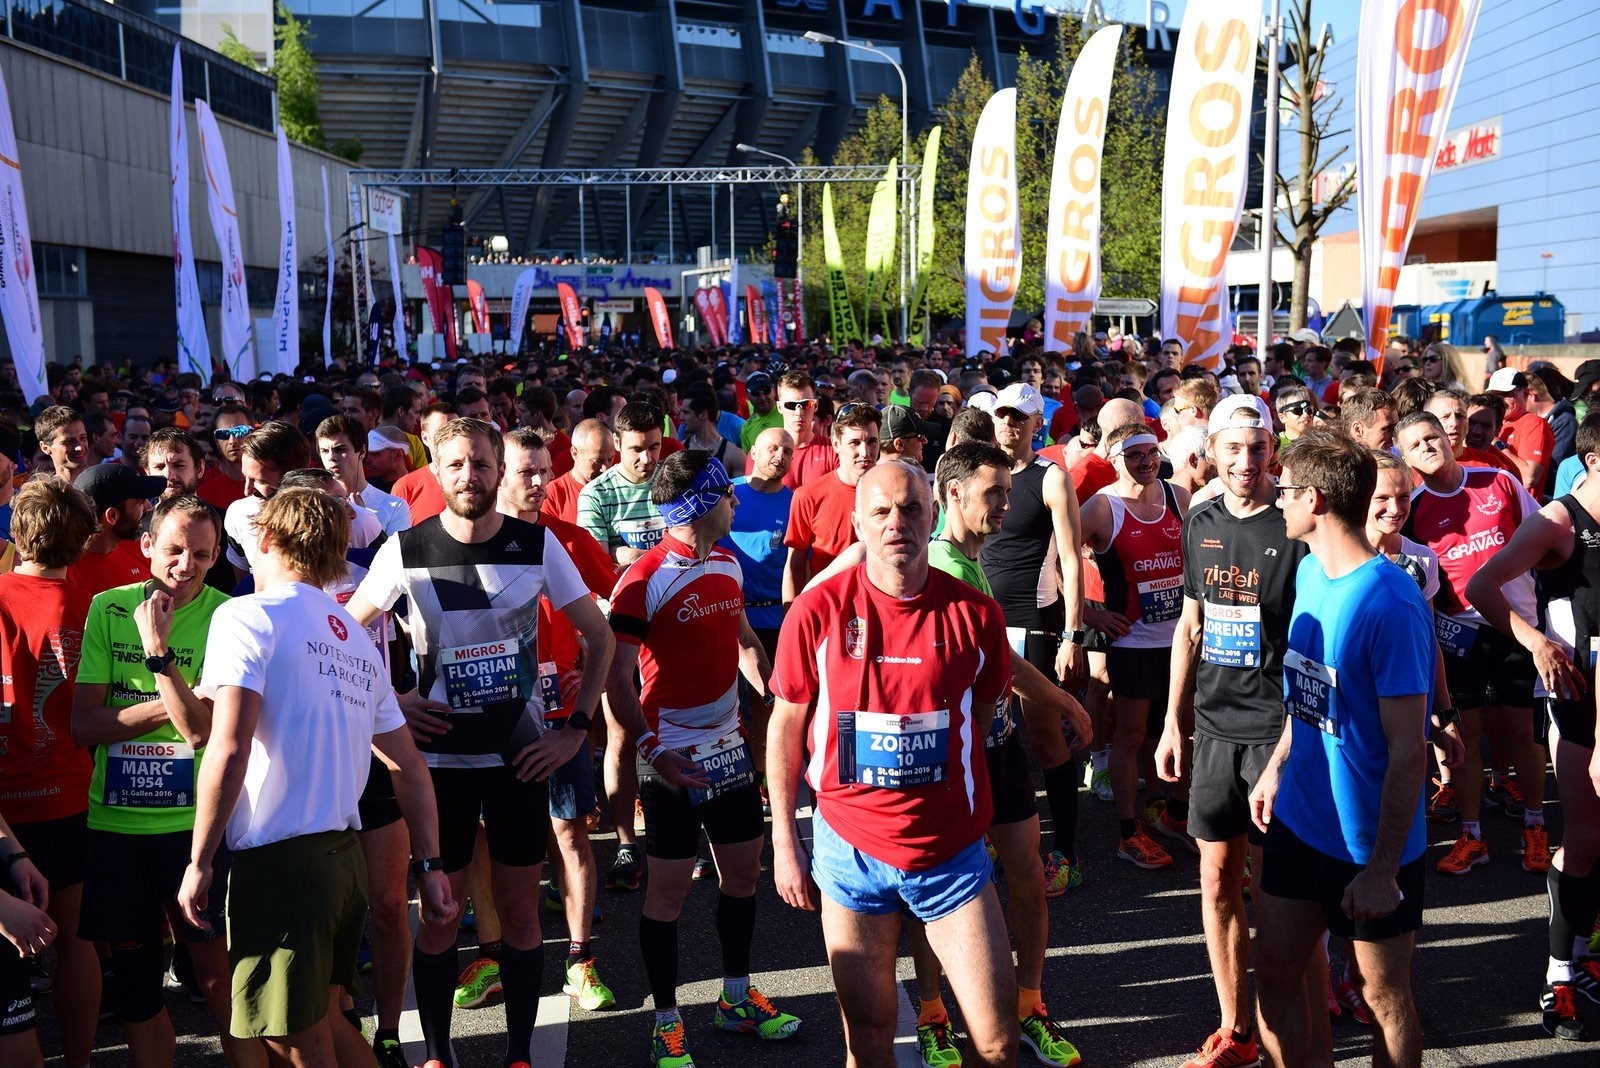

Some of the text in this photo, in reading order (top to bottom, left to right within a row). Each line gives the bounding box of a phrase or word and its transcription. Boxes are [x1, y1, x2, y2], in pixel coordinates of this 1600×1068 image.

[627, 530, 664, 543] NICOL
[645, 541, 655, 549] 18
[1447, 531, 1505, 560] GRAVAG
[1134, 556, 1181, 572] GRAVAG
[1150, 578, 1180, 590] MIGROS
[1154, 588, 1180, 602] FELIX
[1164, 600, 1174, 609] 99
[1436, 617, 1462, 633] RETO
[1437, 628, 1455, 640] 1957
[1215, 636, 1222, 647] 3
[455, 643, 506, 660] MIGROS
[306, 641, 378, 678] NOTENSTEIN
[448, 656, 516, 679] FLORIAN
[477, 675, 493, 687] 13
[1296, 672, 1326, 699] MARC
[494, 685, 508, 694] 2016
[1302, 693, 1318, 708] 106
[870, 733, 937, 752] ZORAN
[122, 744, 175, 756] MIGROS
[703, 747, 745, 772] ROMAN
[896, 753, 914, 766] 10
[122, 760, 174, 775] MARC
[723, 765, 736, 777] 34
[914, 766, 931, 774] 2016
[130, 776, 164, 788] 1954
